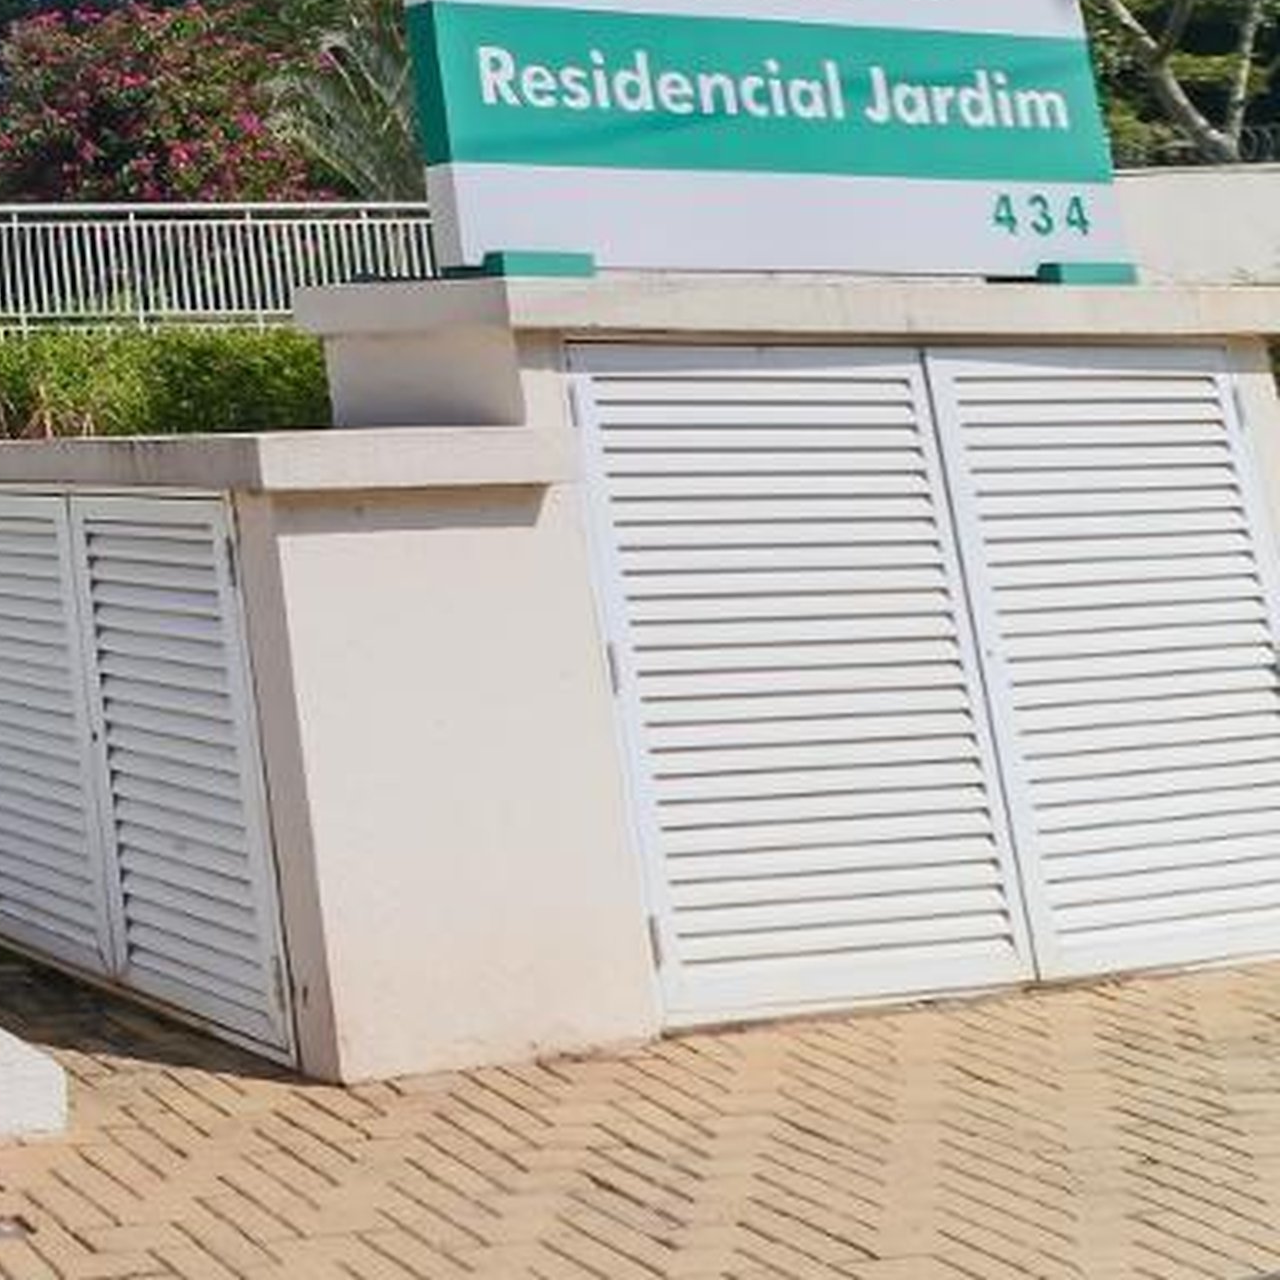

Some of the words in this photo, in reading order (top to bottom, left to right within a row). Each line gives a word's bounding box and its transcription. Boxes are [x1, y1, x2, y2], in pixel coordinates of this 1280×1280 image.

[477, 45, 844, 121] Residencial
[864, 66, 1069, 129] Jardim
[993, 194, 1089, 236] 434
